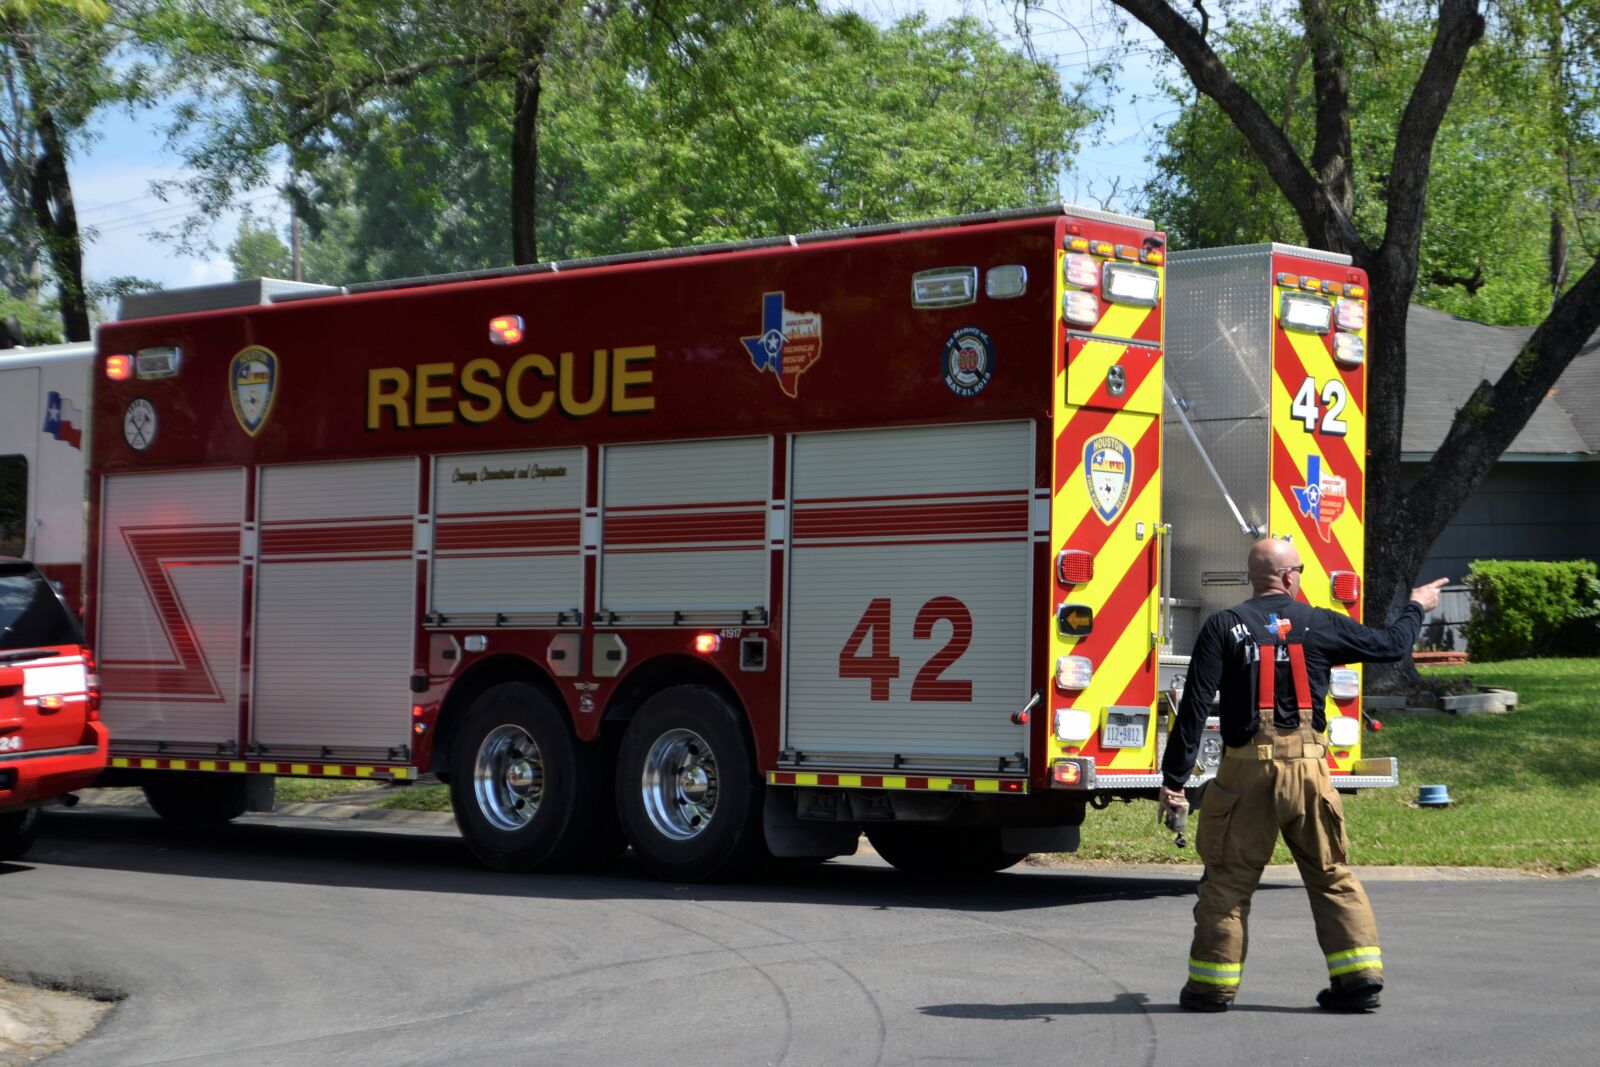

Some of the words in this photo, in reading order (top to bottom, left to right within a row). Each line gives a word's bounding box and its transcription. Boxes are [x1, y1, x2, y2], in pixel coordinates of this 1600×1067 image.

[366, 345, 656, 431] RESCUE
[1290, 376, 1347, 437] 42
[1093, 438, 1124, 455] HOUSTON
[720, 629, 742, 638] 41917
[838, 595, 973, 702] 42
